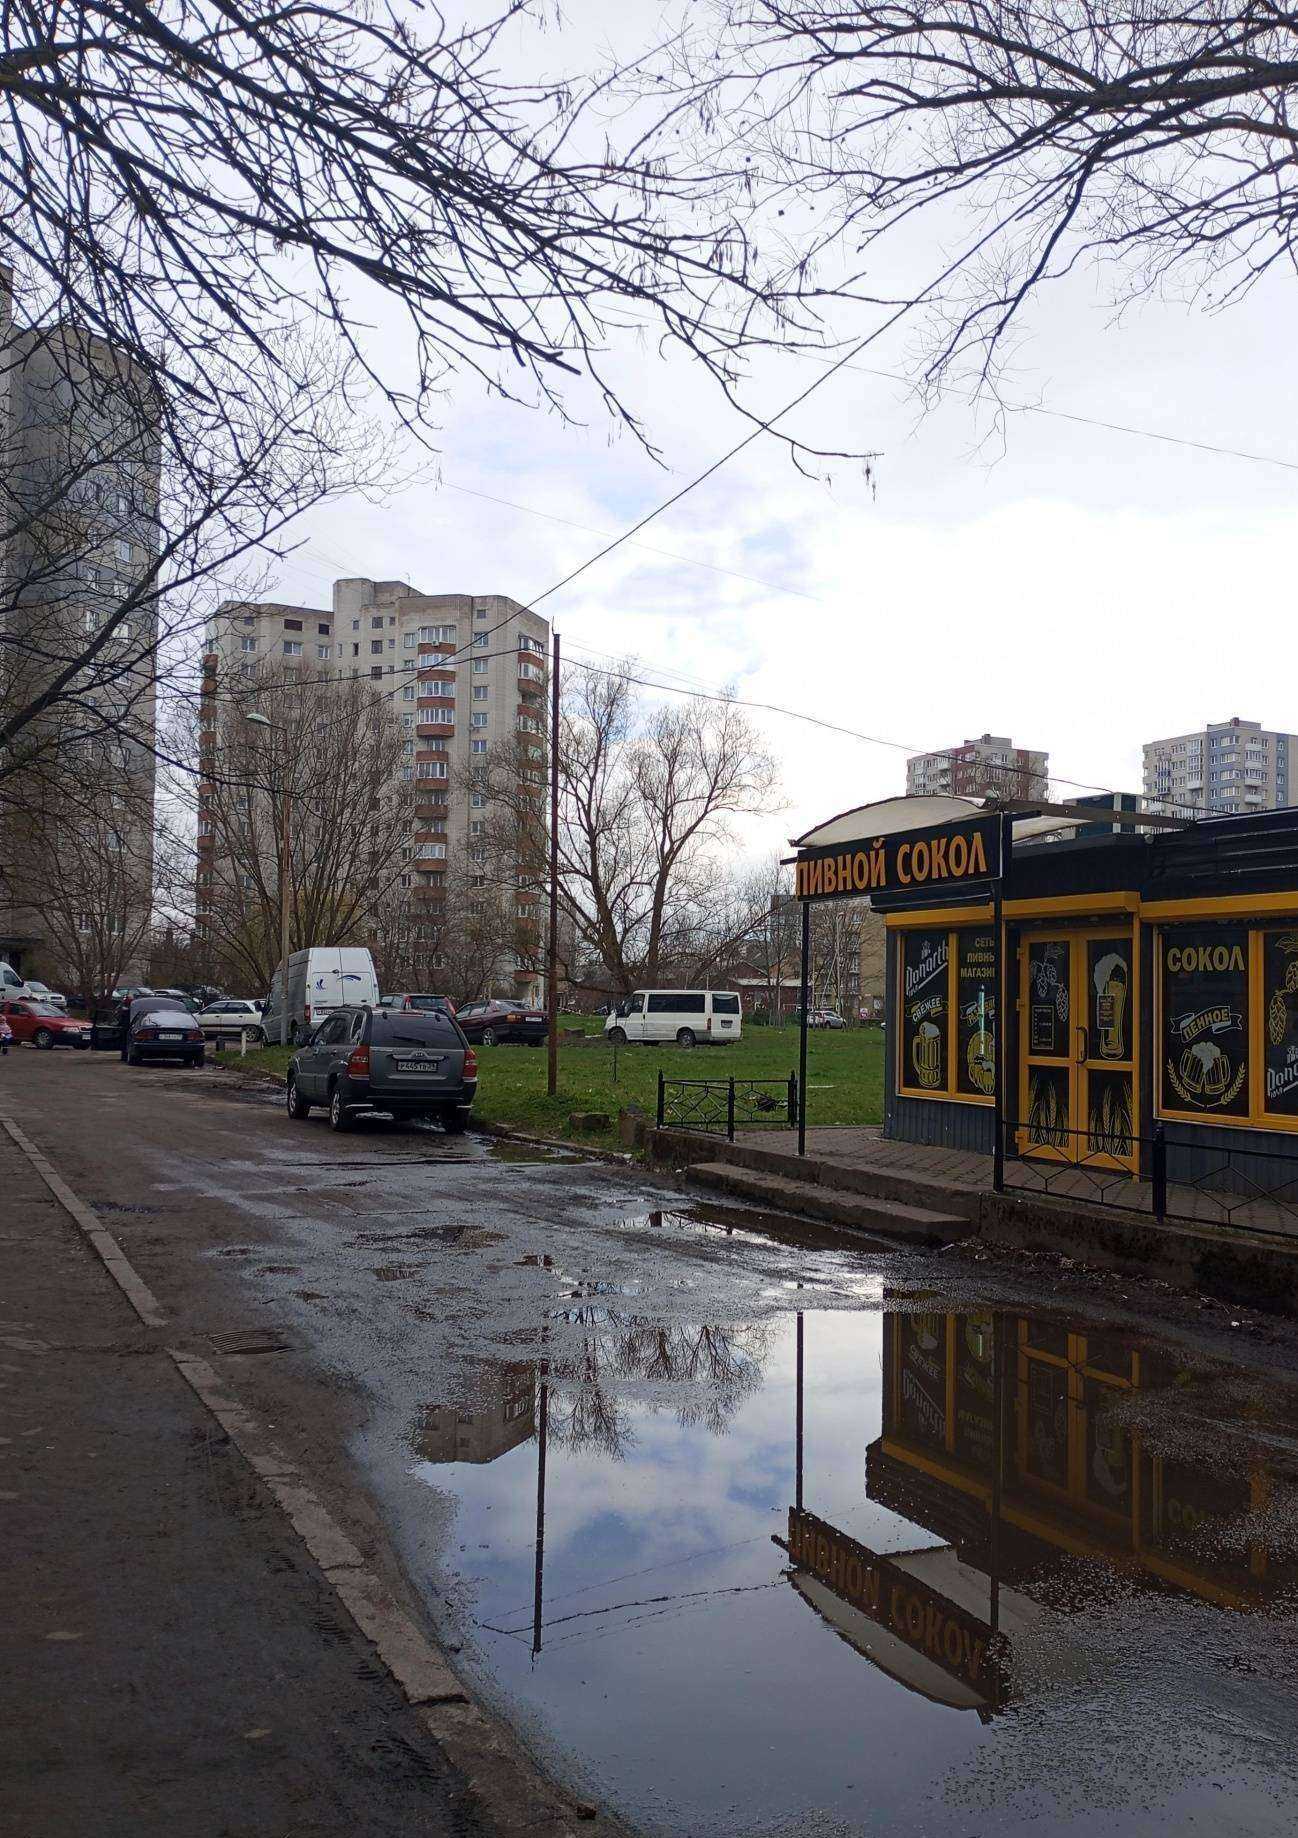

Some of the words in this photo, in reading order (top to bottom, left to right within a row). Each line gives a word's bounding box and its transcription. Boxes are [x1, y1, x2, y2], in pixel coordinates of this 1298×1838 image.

[796, 838, 887, 898] ПИВНОЙ
[897, 832, 987, 884] СОКОЛ
[1167, 945, 1245, 972] СОКОЛ
[912, 997, 941, 1021] СВЕЖЕЕ
[1184, 1008, 1229, 1039] ПЕННОЕ
